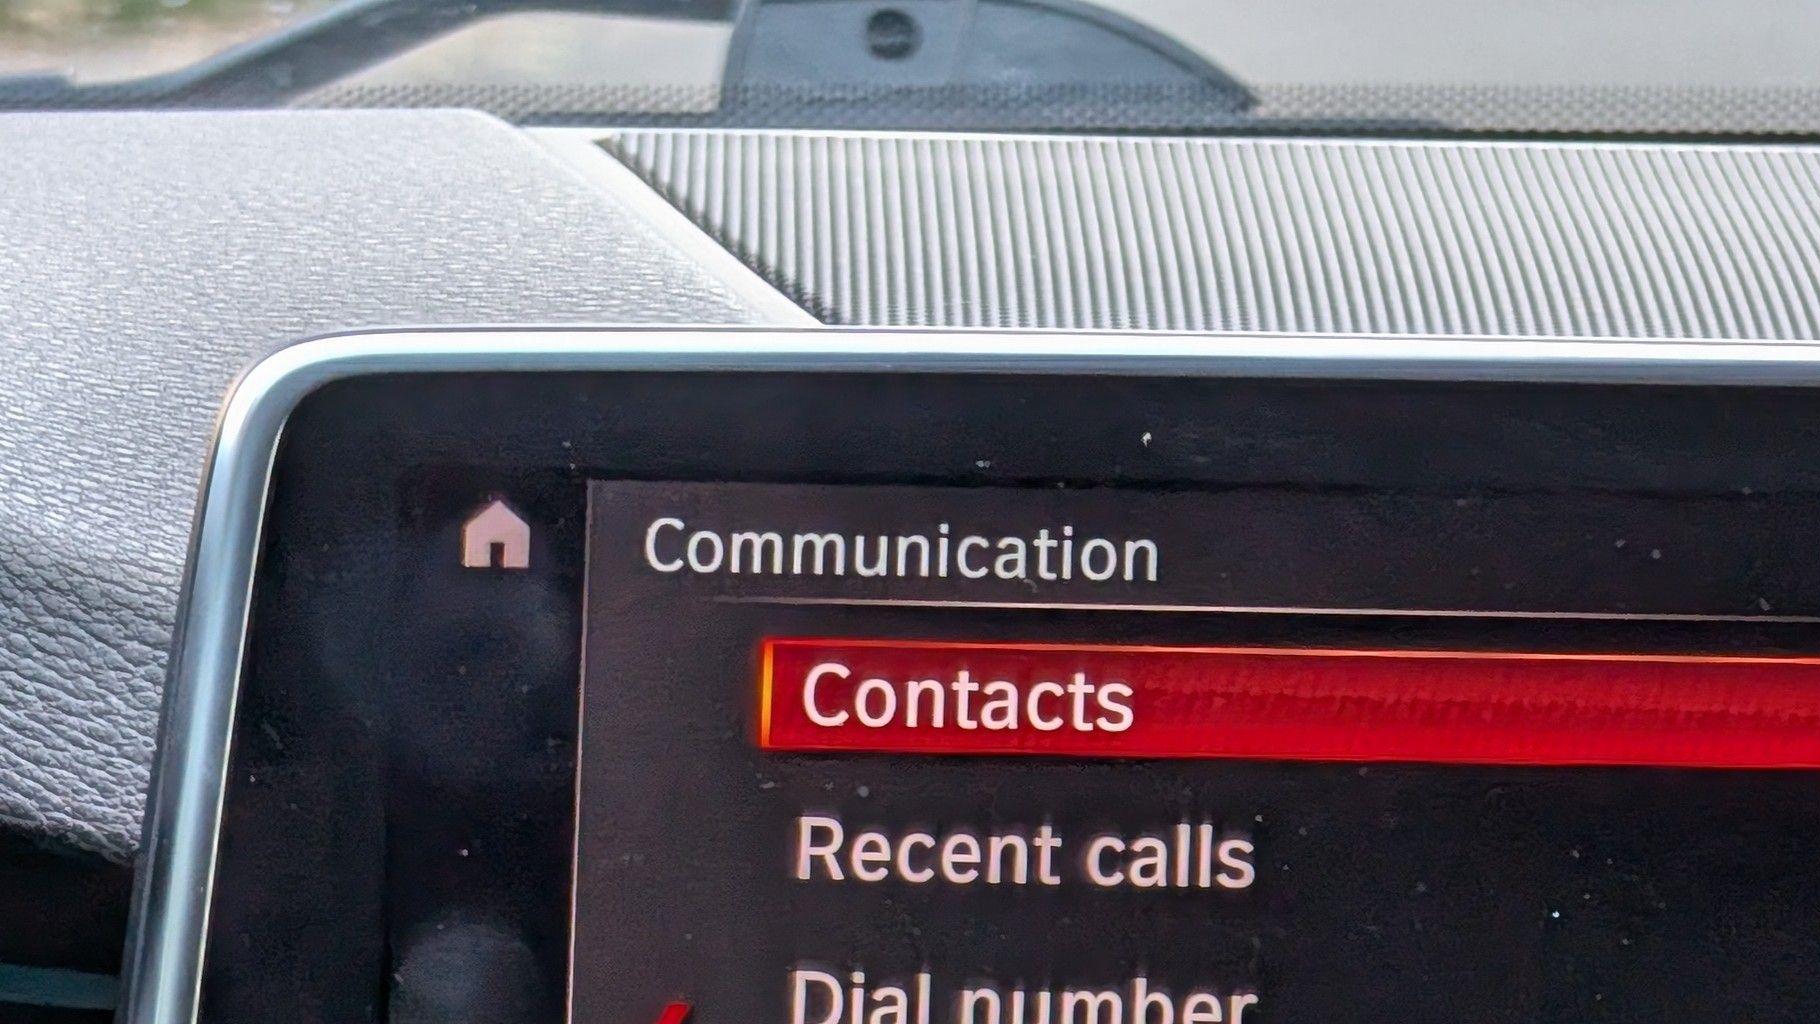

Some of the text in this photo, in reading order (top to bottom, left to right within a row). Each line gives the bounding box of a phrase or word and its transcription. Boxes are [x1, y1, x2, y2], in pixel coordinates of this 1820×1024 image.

[644, 517, 1158, 582] Communication
[803, 662, 1134, 732] Contacts
[796, 816, 1255, 889] Recent calls
